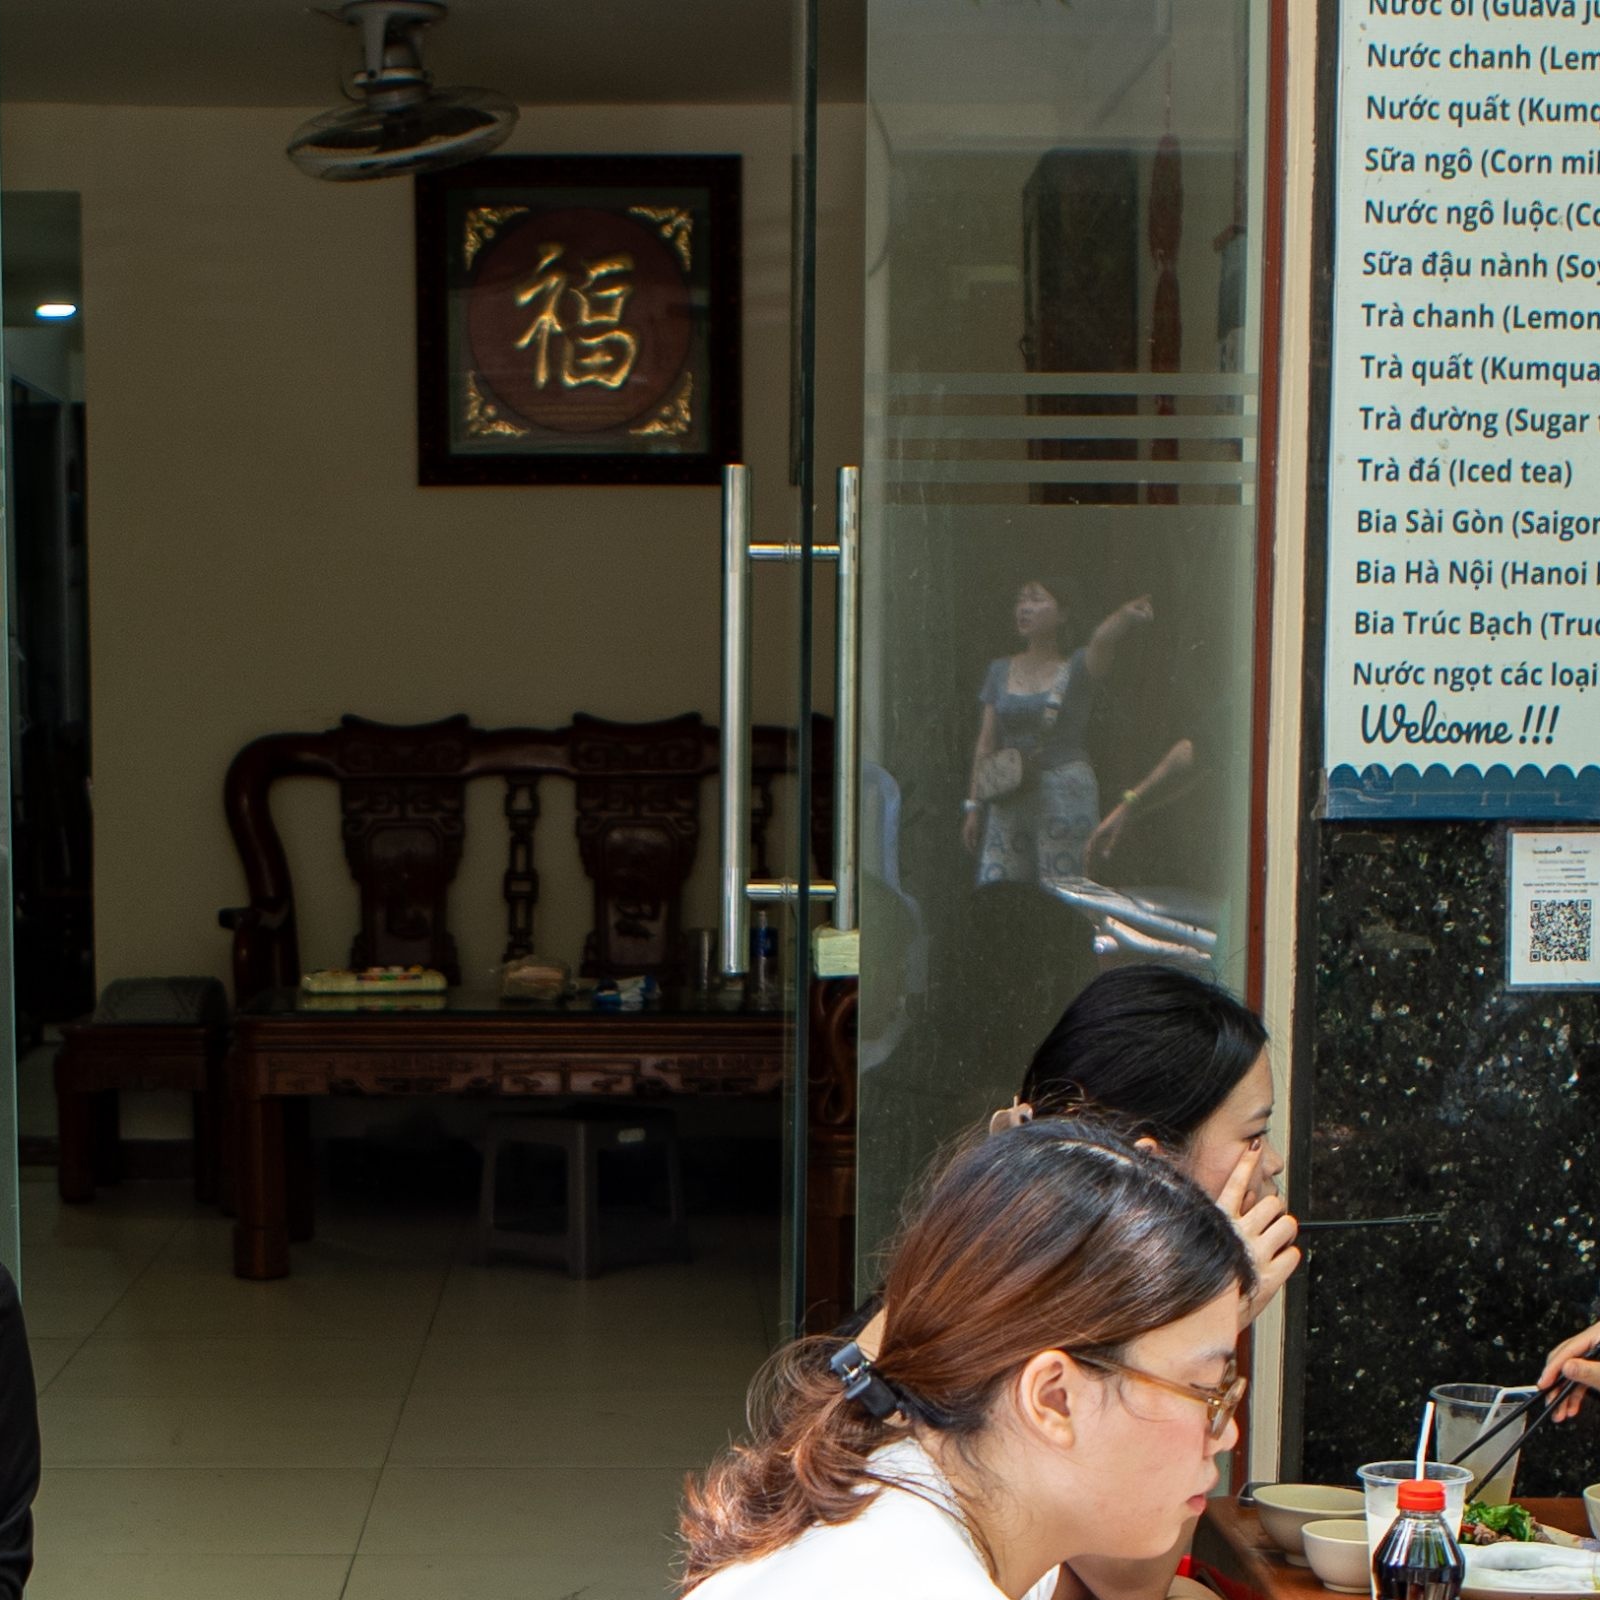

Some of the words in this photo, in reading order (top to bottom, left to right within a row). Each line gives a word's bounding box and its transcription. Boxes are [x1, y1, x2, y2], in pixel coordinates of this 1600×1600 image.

[1367, 41, 1441, 70] Nước
[1449, 42, 1531, 70] chanh
[1367, 93, 1440, 122] Nước
[1448, 95, 1510, 128] quất
[1365, 147, 1415, 173] Sữa
[1425, 146, 1473, 181] ngô
[1481, 149, 1552, 179] (Corn
[1365, 198, 1438, 226] Nước
[1446, 199, 1494, 232] ngô
[1503, 199, 1558, 232] luộc
[1362, 251, 1412, 277] Sữa
[1422, 251, 1471, 284] đậu
[1481, 251, 1548, 279] nành
[514, 246, 638, 390] 福
[1361, 301, 1404, 328] Trà
[1413, 302, 1494, 329] chanh
[1360, 354, 1403, 380] Trà
[1411, 354, 1473, 387] quất
[1359, 405, 1401, 432] Trà
[1410, 405, 1499, 440] đường
[1505, 407, 1590, 441] (Sugar
[1357, 457, 1400, 483] Trà
[1408, 456, 1440, 483] đá
[1449, 458, 1512, 488] (Iced
[1520, 460, 1572, 489] tea)
[1356, 508, 1398, 535] Bia
[1405, 508, 1444, 535] Sài
[1452, 508, 1503, 535] Gòn
[1356, 559, 1396, 585] Bia
[1405, 559, 1439, 585] Hà
[1448, 558, 1494, 590] Nội
[1501, 560, 1588, 590] (Hanoi
[1355, 610, 1394, 636] Bia
[1402, 610, 1461, 636] Trúc
[1469, 610, 1532, 642] Bạch
[1352, 659, 1425, 687] Nước
[1433, 664, 1493, 694] ngọt
[1500, 660, 1543, 687] các
[1551, 661, 1598, 693] loại
[1360, 699, 1513, 745] Welcome
